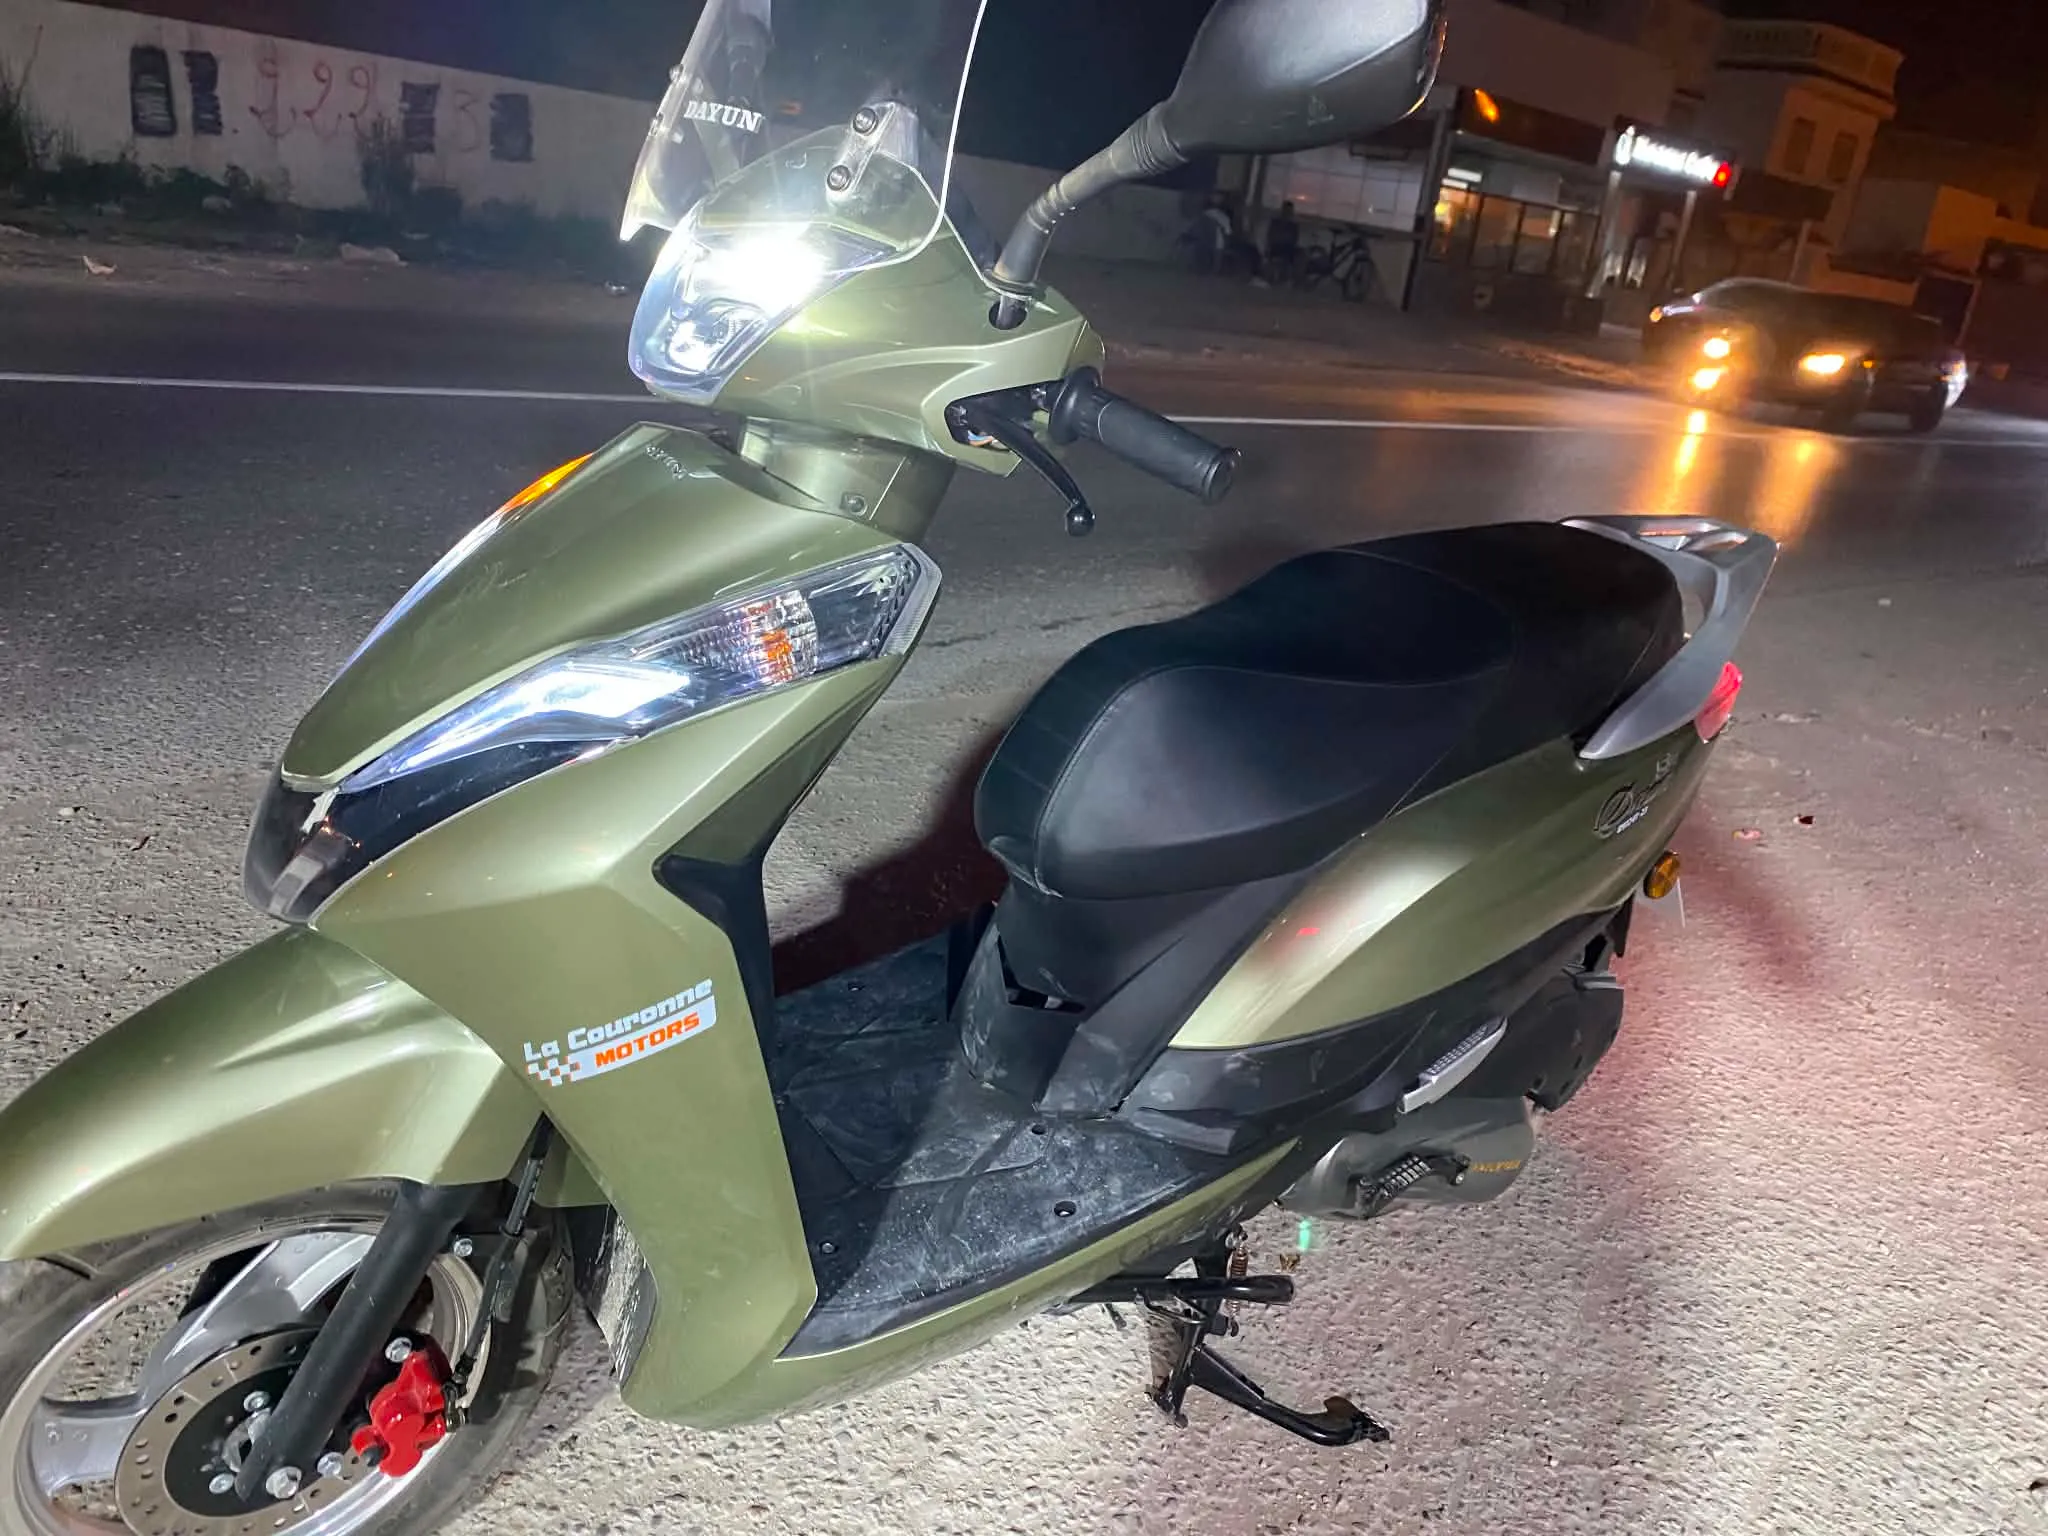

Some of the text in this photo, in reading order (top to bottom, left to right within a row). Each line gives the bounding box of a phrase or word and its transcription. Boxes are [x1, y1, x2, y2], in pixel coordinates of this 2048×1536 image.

[683, 100, 762, 134] DAYUN
[523, 978, 713, 1062] La Couronne
[595, 1012, 700, 1068] MOTORS
